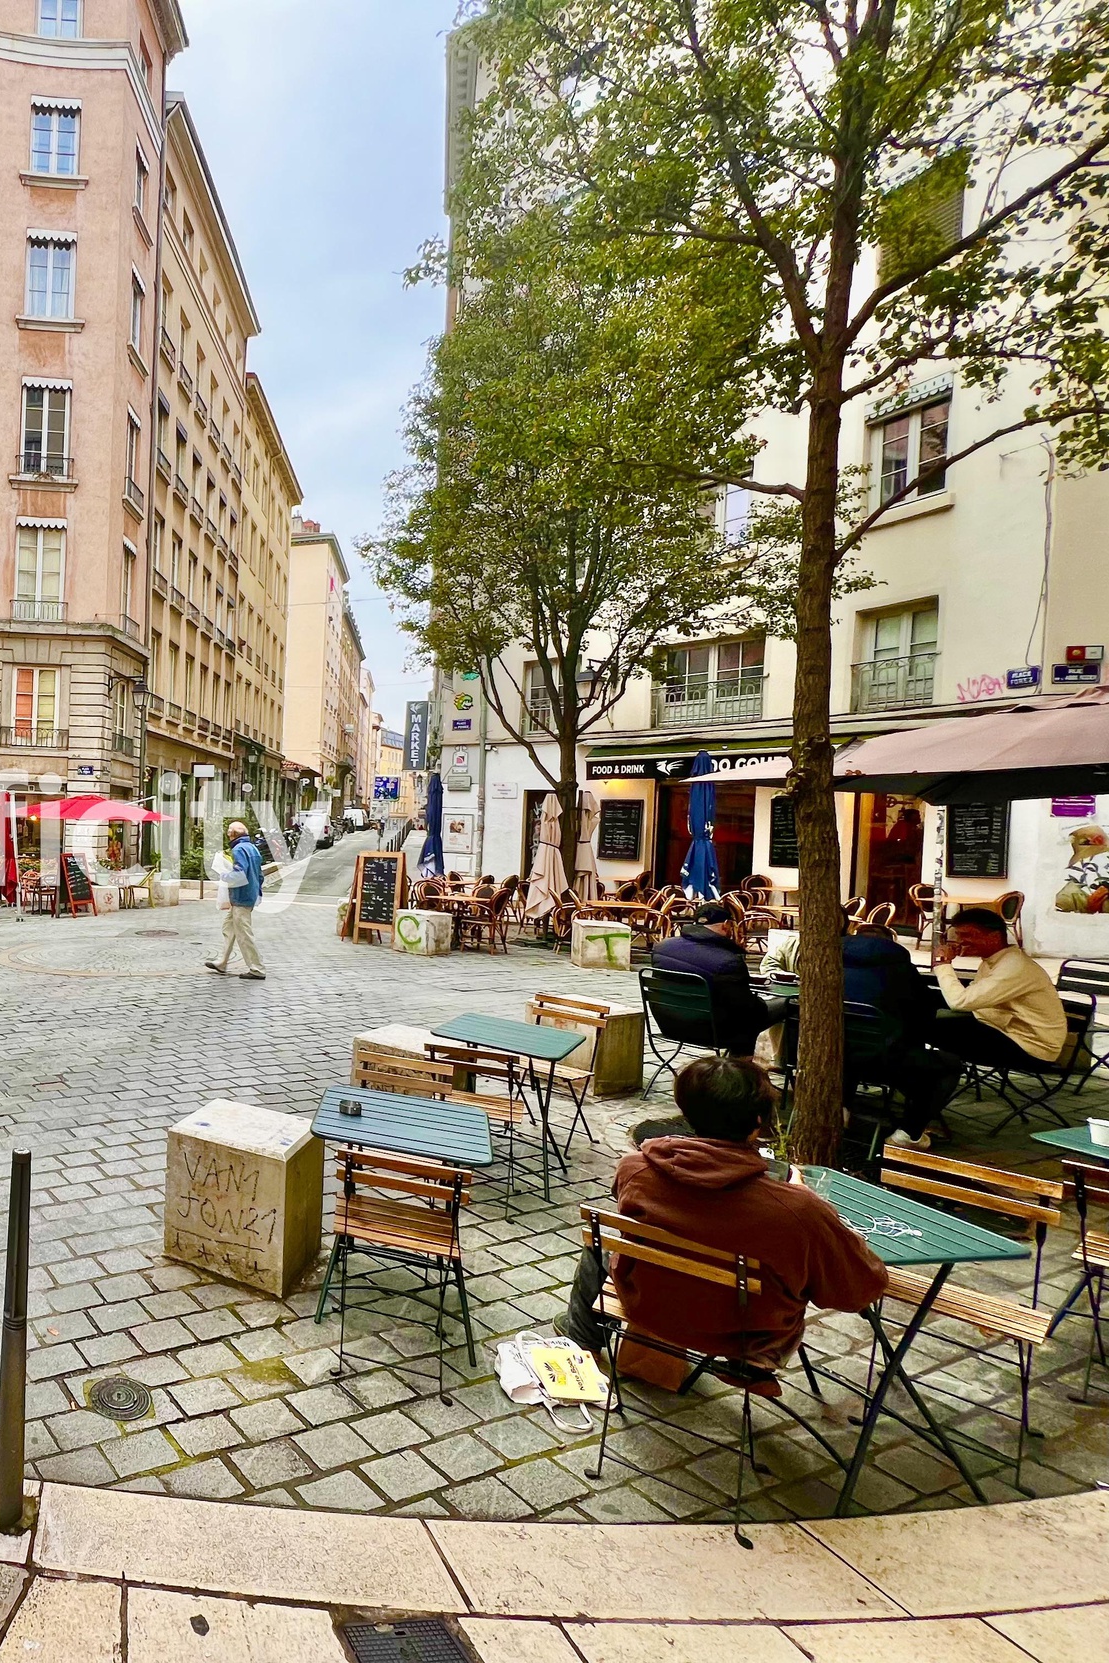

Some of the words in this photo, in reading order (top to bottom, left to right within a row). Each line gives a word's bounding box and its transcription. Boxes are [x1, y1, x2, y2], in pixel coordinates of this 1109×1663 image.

[410, 714, 422, 768] MARKET
[592, 765, 613, 775] FOOD
[613, 764, 620, 774] &
[620, 763, 645, 775] DRINK
